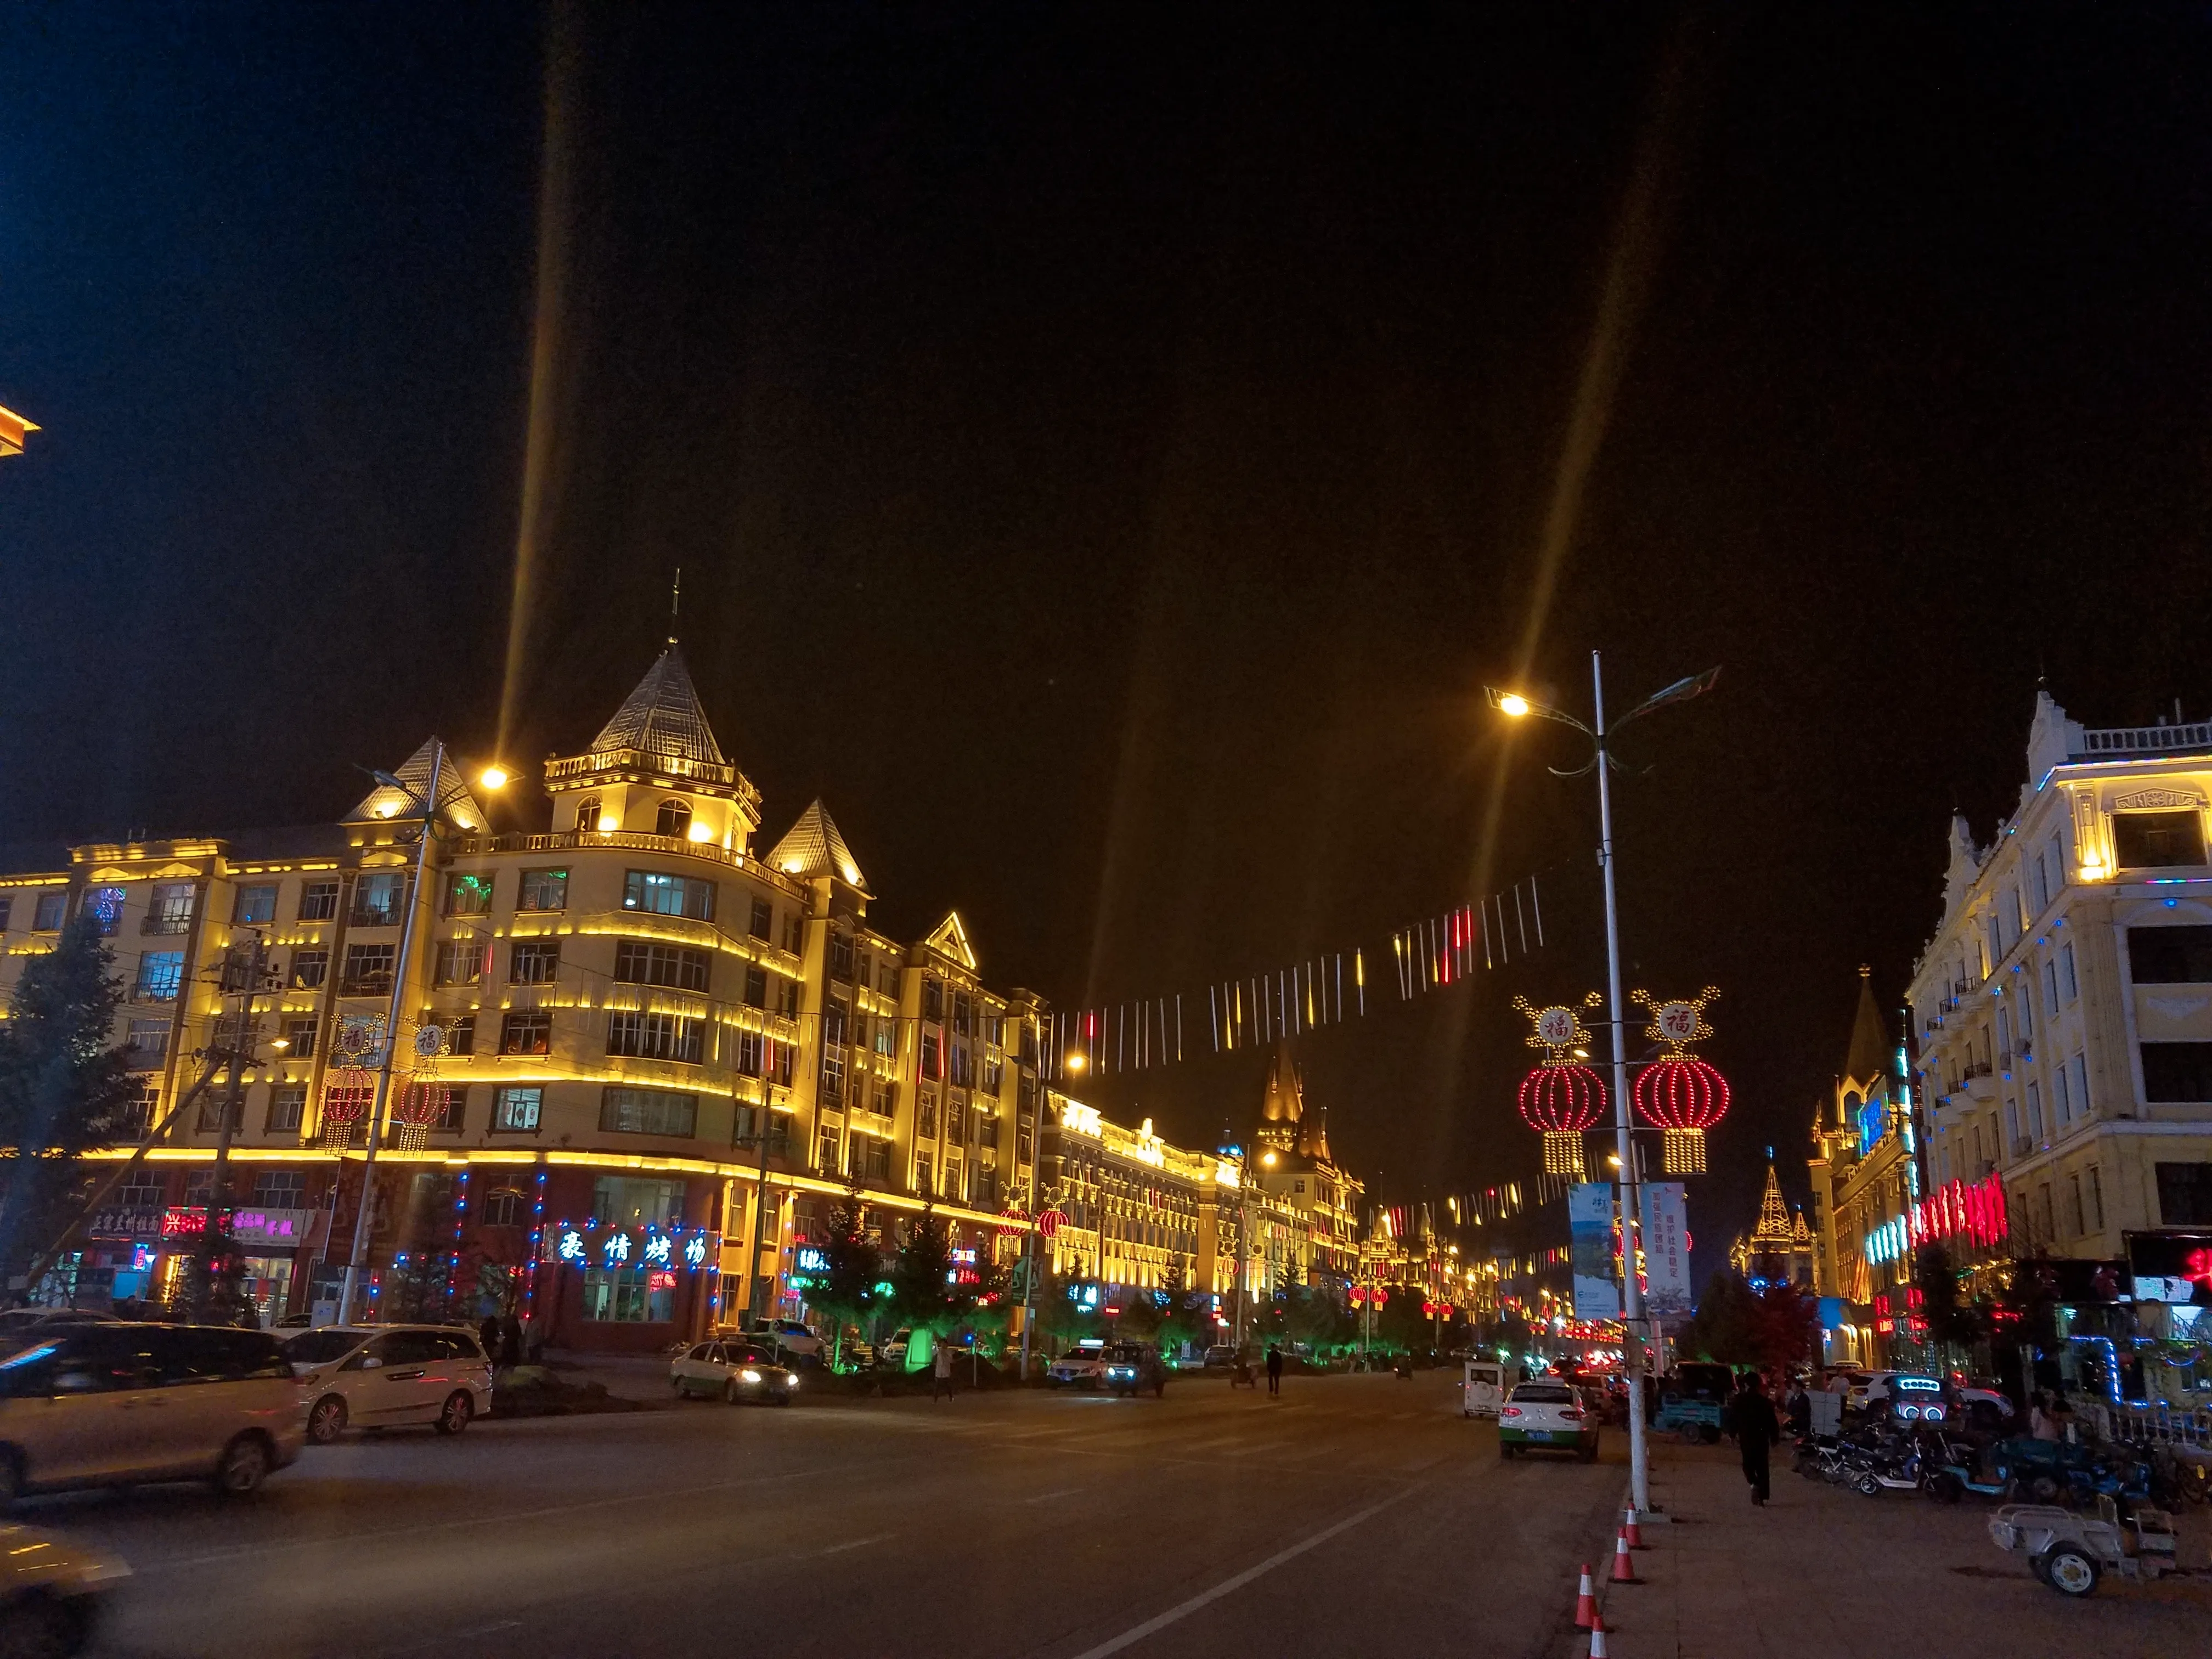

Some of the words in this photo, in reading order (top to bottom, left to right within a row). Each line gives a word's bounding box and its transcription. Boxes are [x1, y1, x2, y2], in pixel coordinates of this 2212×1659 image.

[1544, 1015, 1568, 1038] 福
[1666, 1009, 1690, 1034] 福
[345, 1030, 360, 1048] 福
[419, 1031, 437, 1049] 福
[558, 1231, 707, 1264] 豪情烤场
